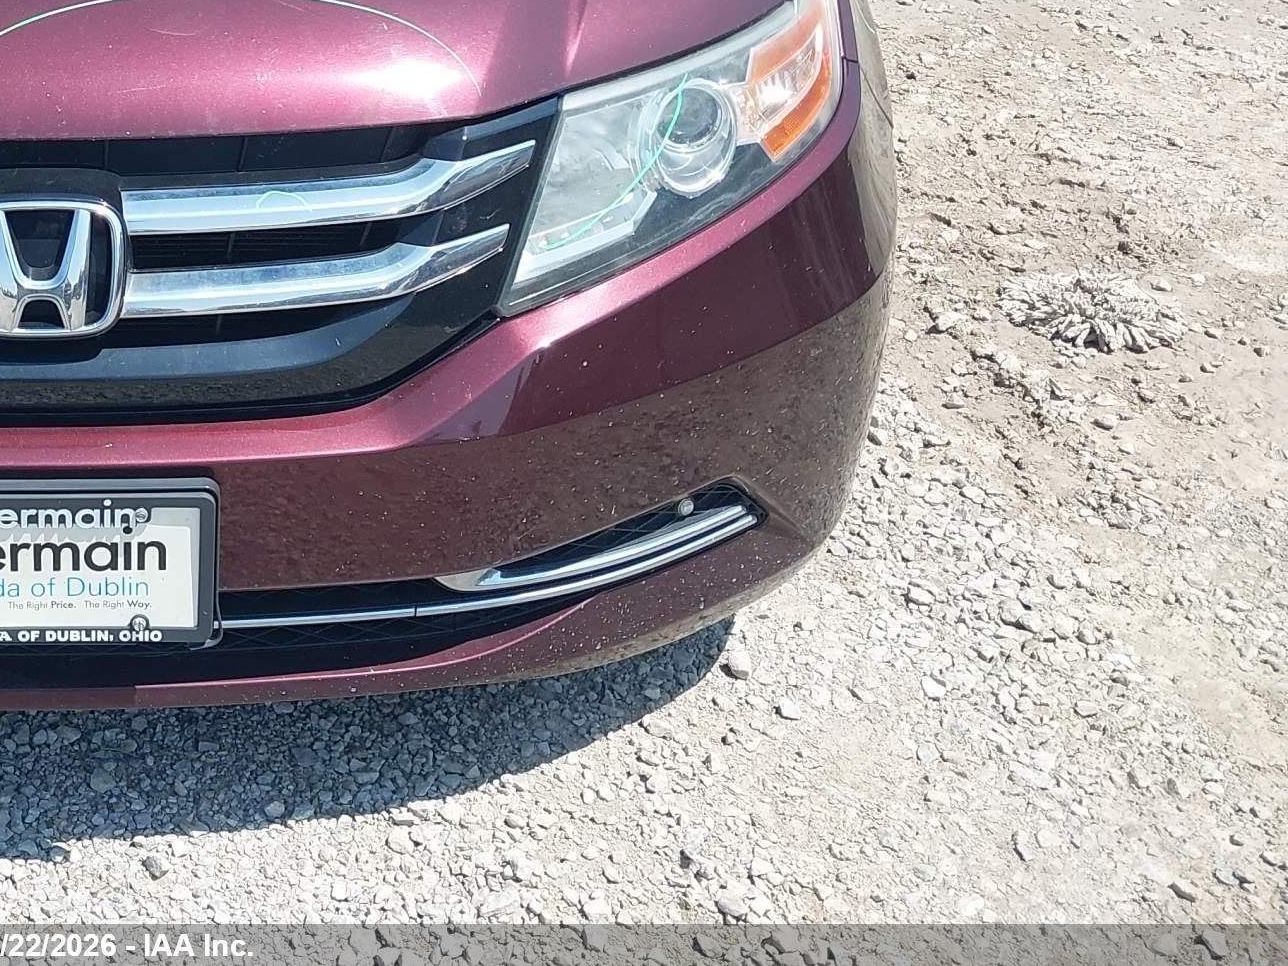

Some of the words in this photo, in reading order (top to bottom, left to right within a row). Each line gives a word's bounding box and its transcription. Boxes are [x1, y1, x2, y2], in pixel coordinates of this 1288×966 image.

[30, 577, 56, 597] of
[67, 576, 150, 597] Dublin
[8, 601, 23, 610] The
[26, 601, 48, 611] Right
[50, 601, 77, 610] Price.
[84, 600, 99, 609] The
[102, 600, 124, 610] Right
[127, 600, 153, 610] Way.
[17, 631, 40, 643] OF
[119, 630, 163, 642] OHIO
